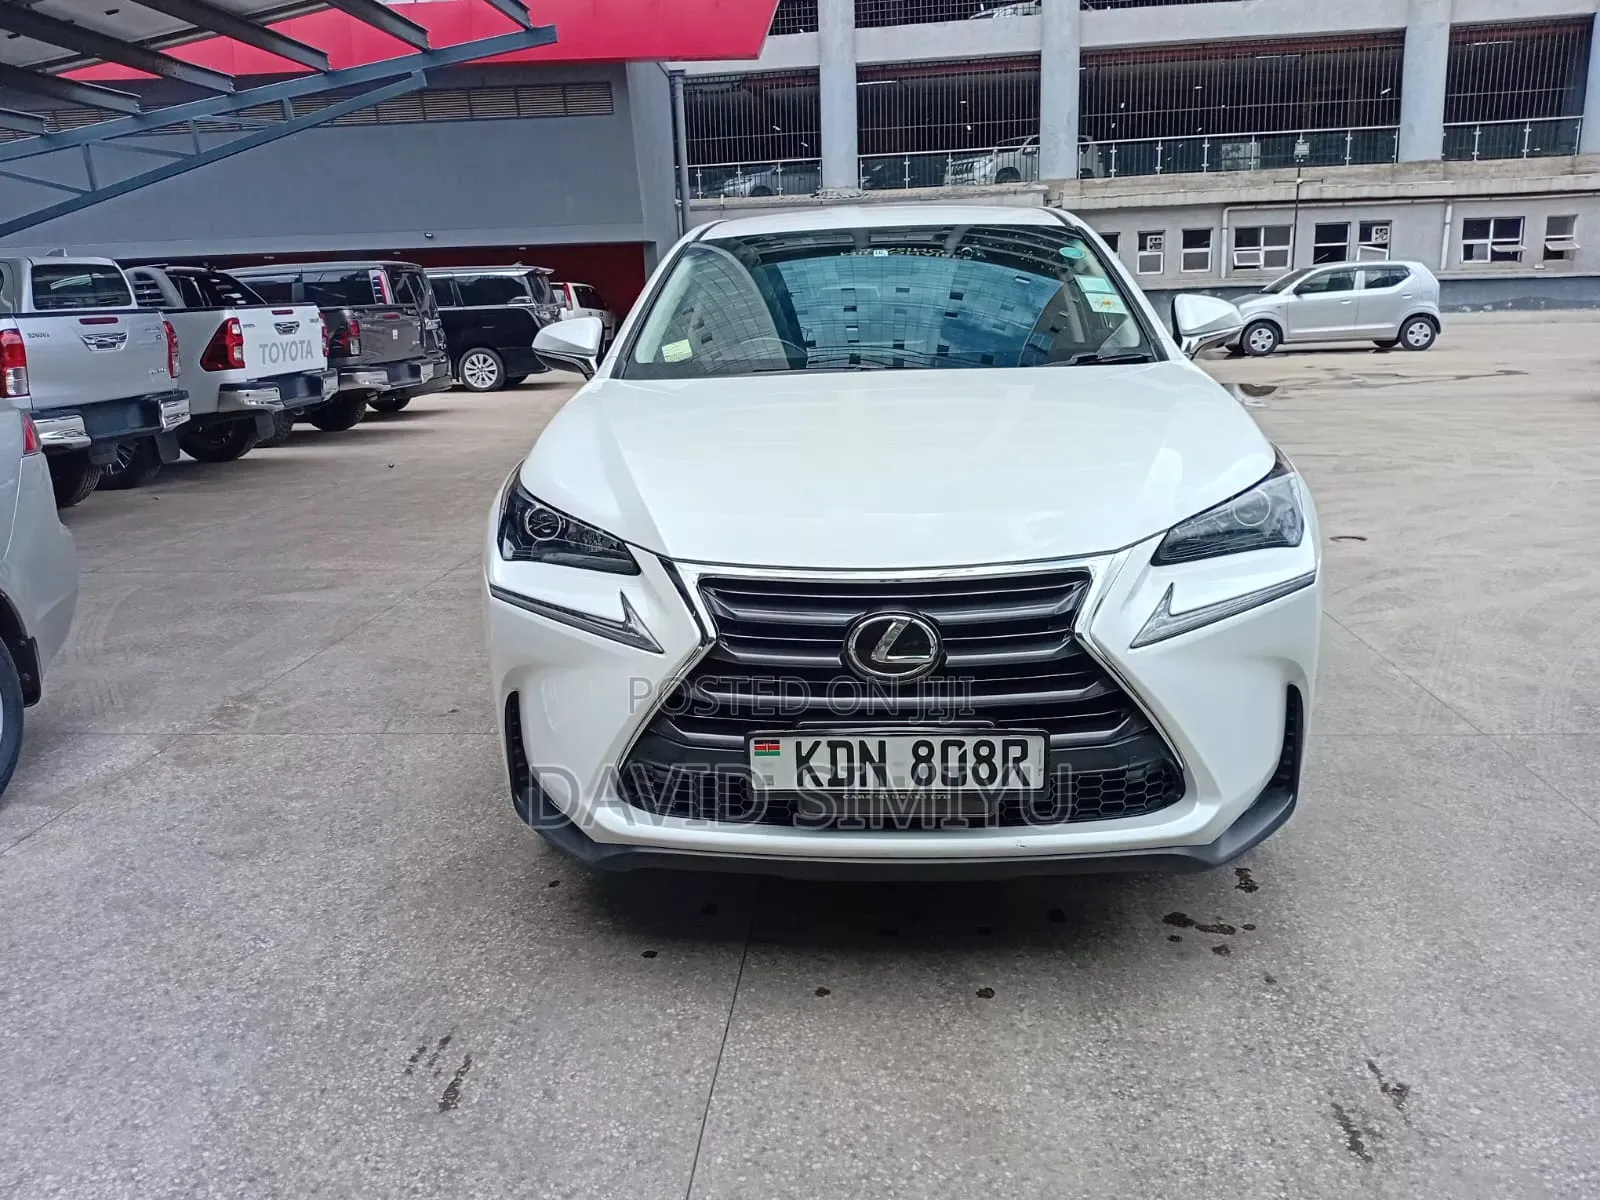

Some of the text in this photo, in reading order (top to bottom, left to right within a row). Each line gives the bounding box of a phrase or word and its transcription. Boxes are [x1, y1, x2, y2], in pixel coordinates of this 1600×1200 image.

[259, 340, 314, 365] TOYOTA
[795, 740, 887, 787] KDN
[911, 739, 1031, 787] 808R
